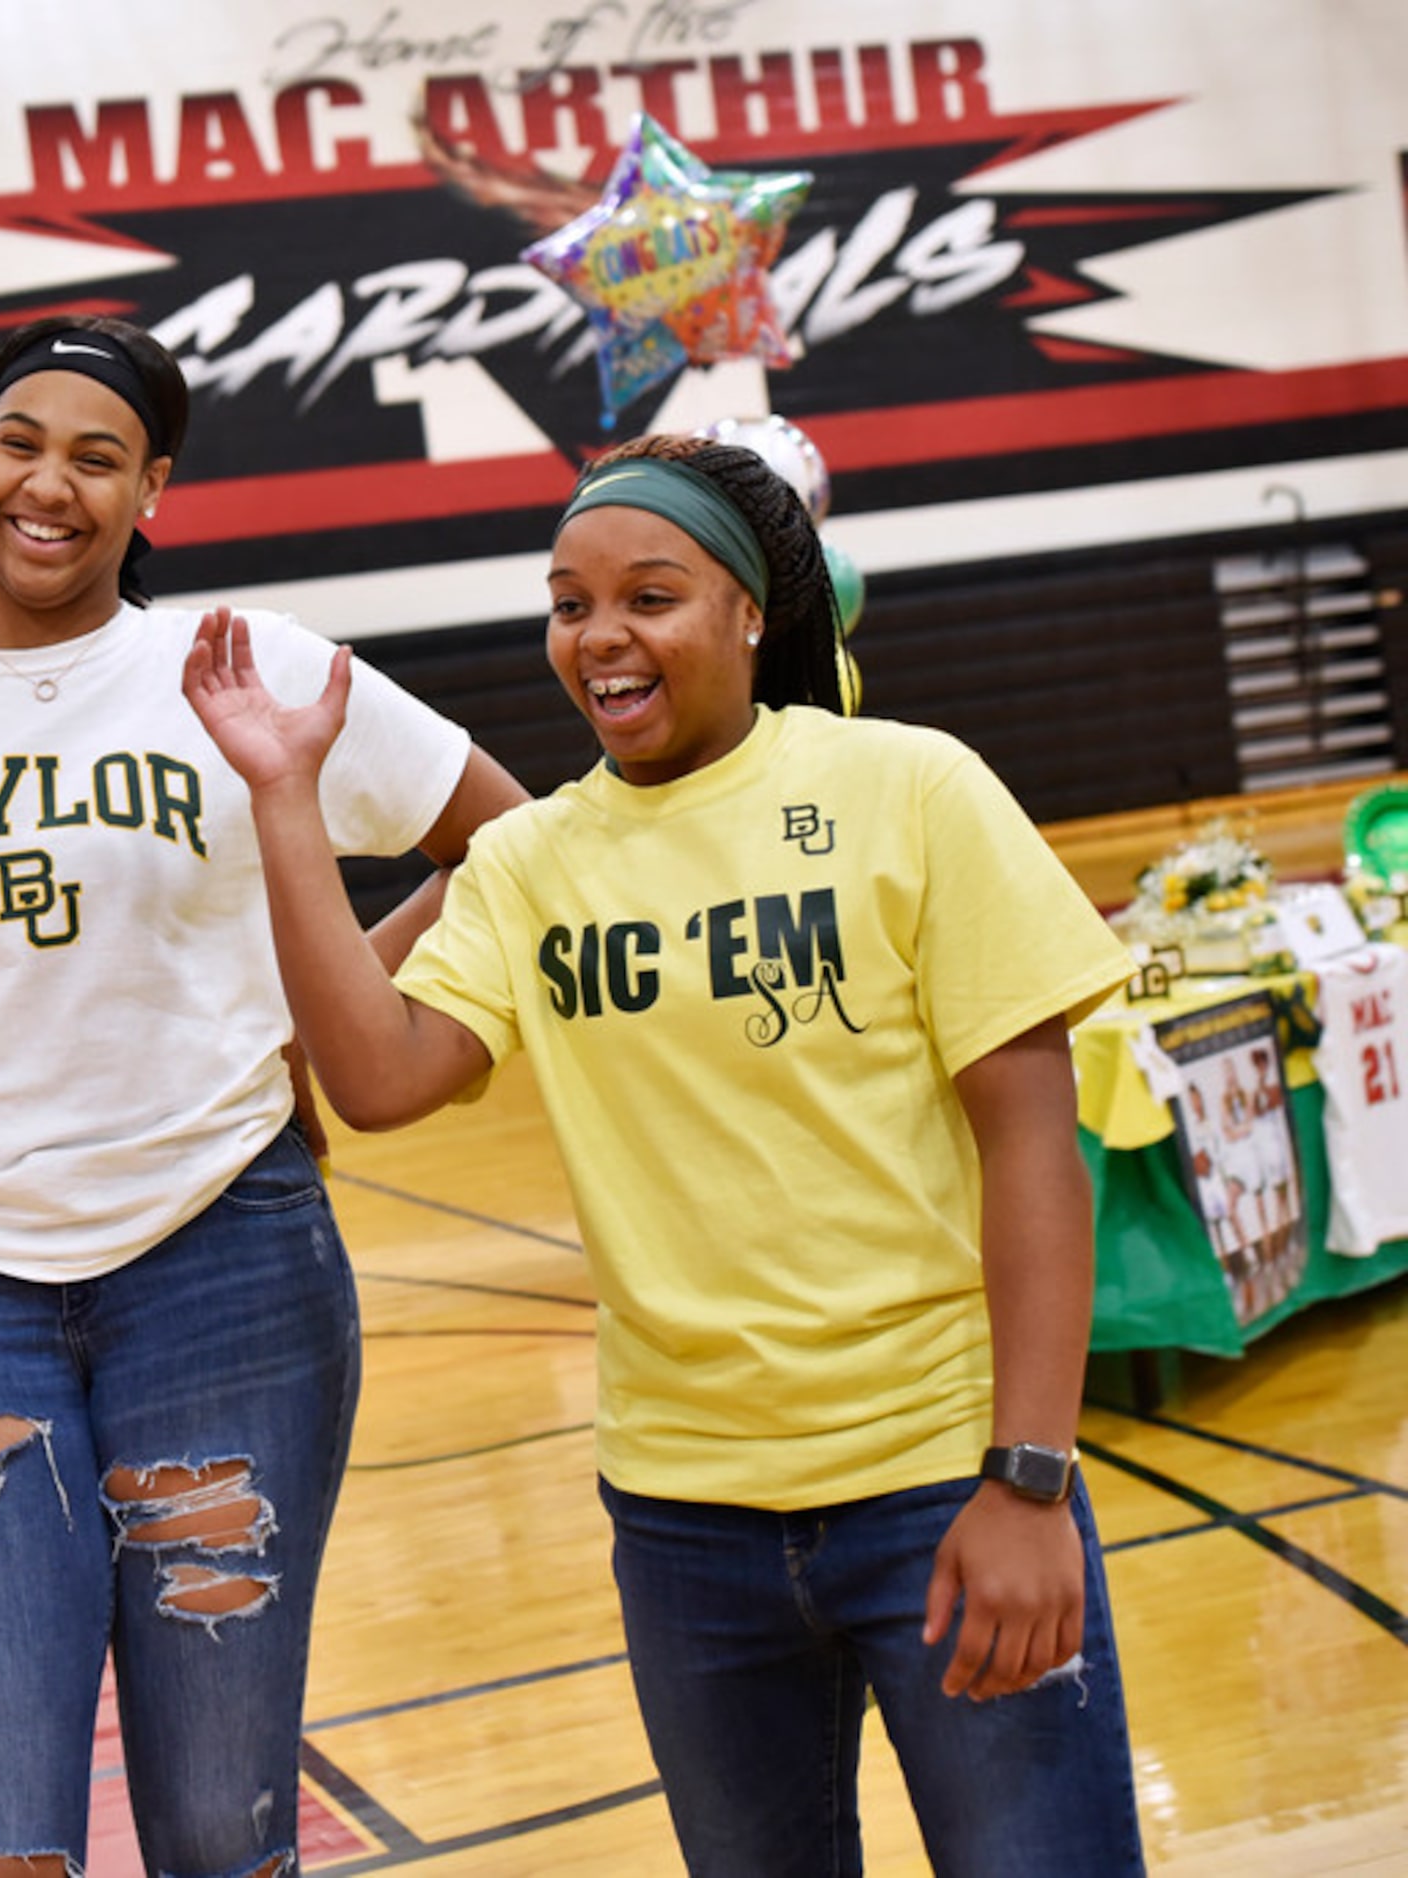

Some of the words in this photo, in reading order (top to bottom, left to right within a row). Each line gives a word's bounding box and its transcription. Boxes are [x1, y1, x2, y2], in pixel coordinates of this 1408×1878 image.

[265, 10, 500, 88] Home
[495, 3, 627, 93] of
[24, 77, 377, 195] MAC
[593, 209, 730, 288] CONGRATS!
[147, 185, 1026, 412] CARDALS
[781, 803, 836, 856] BU
[539, 919, 661, 1020] SIC
[745, 960, 871, 1048] SA
[1361, 1038, 1400, 1106] 21
